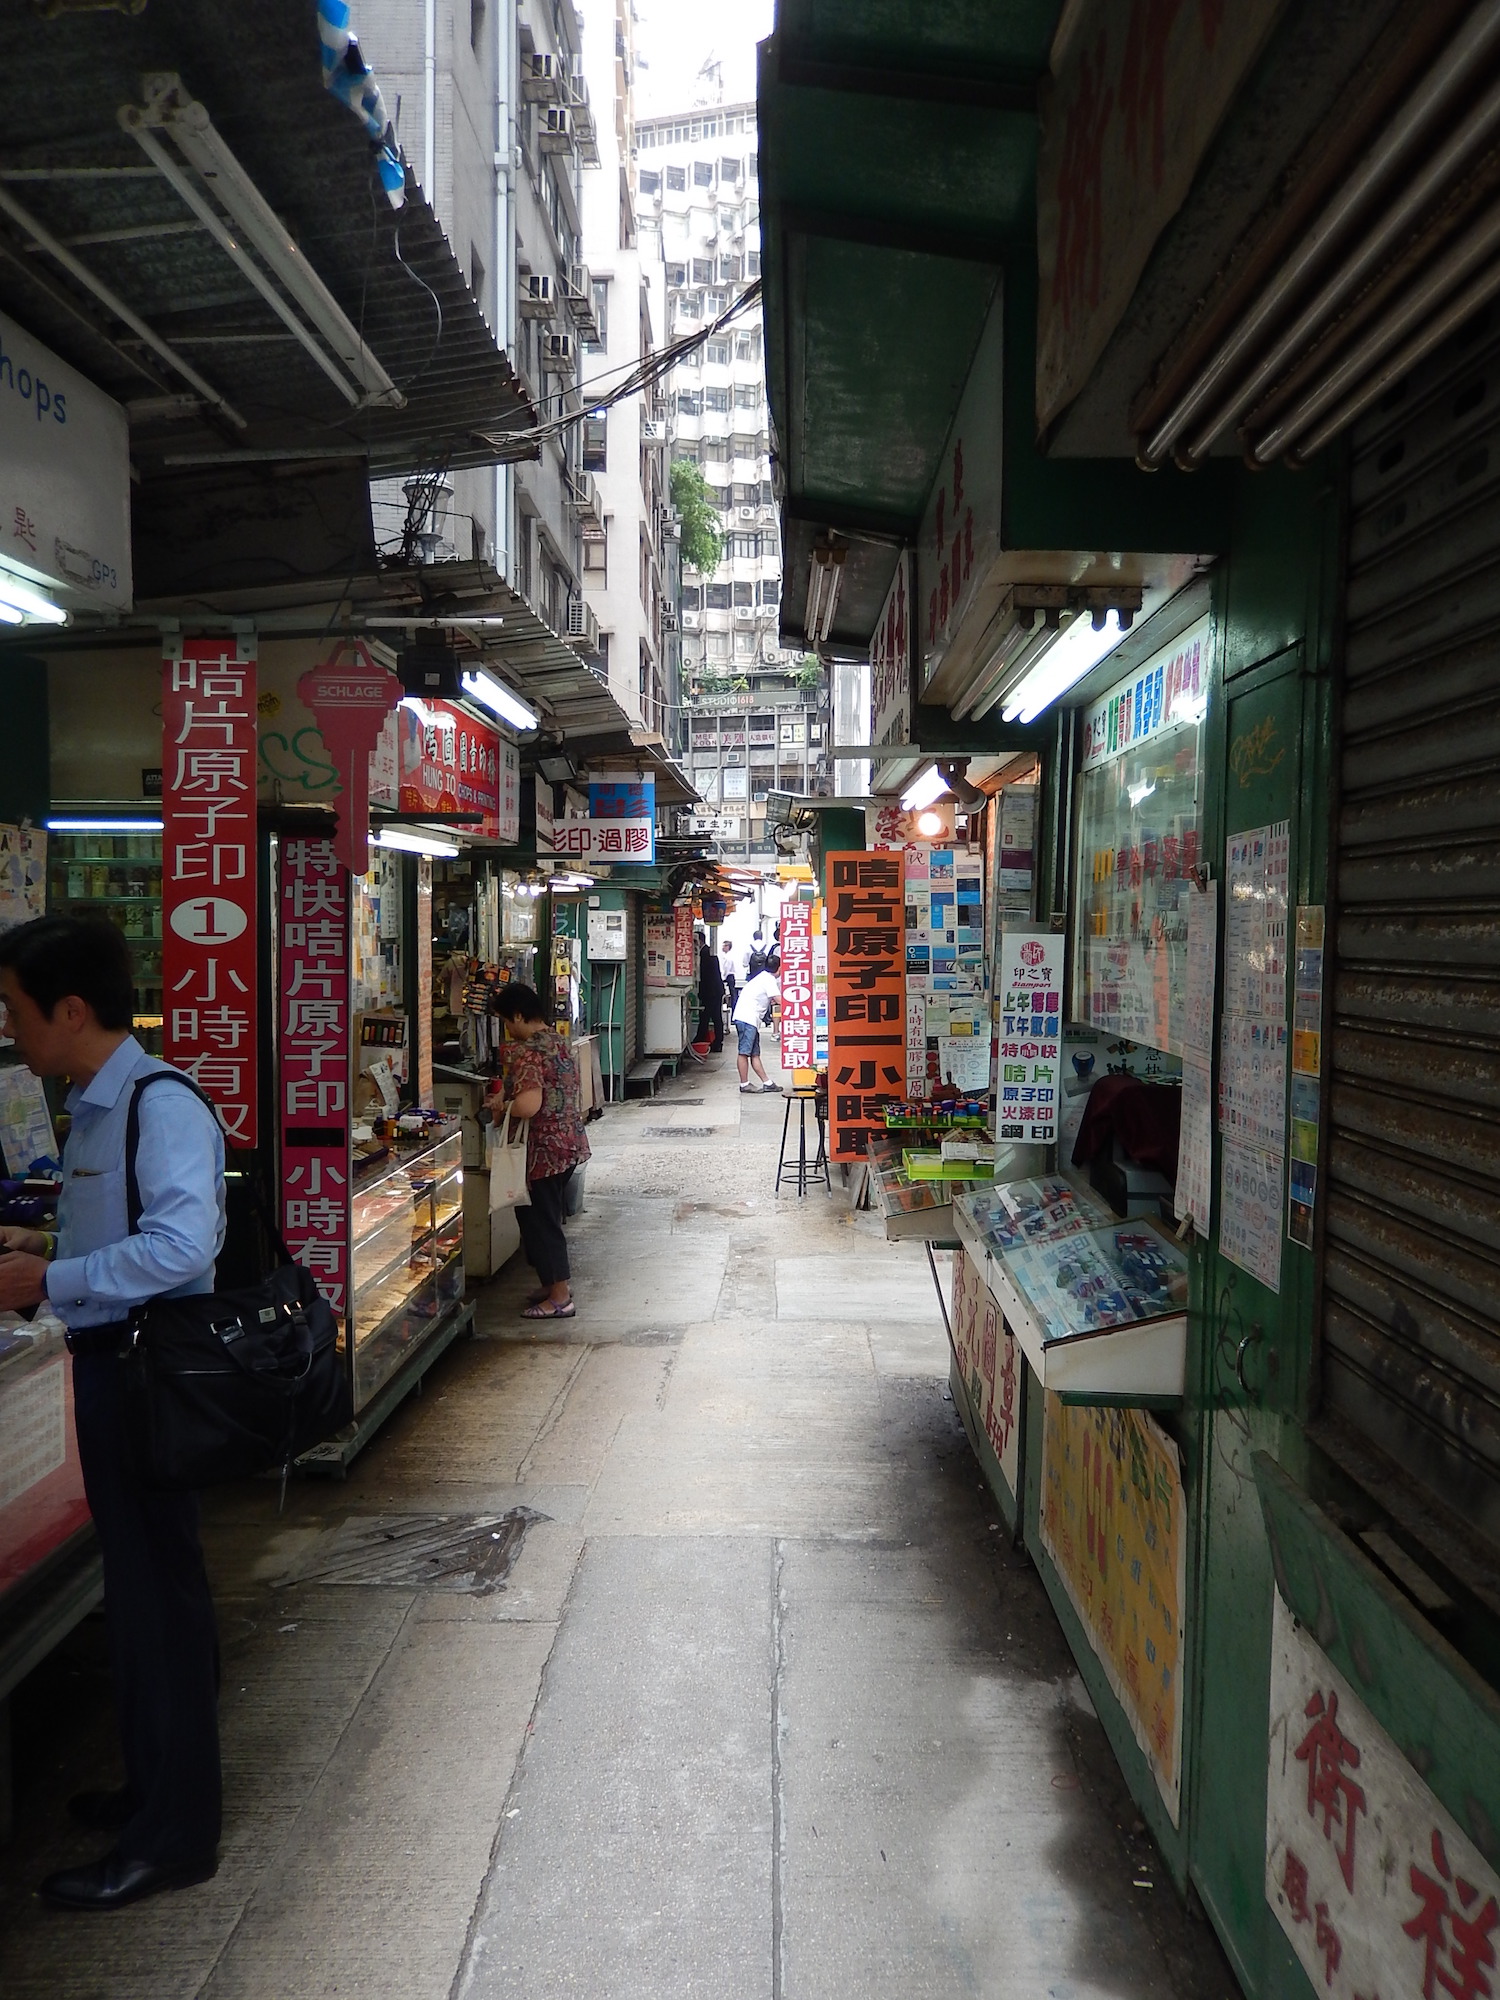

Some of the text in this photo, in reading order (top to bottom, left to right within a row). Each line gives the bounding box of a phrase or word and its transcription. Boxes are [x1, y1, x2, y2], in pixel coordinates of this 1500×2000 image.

[92, 559, 117, 589] GP3
[317, 685, 383, 698] SCHLAGE
[693, 739, 718, 747] KOON
[422, 763, 443, 792] HUNG
[445, 771, 457, 797] TO
[458, 782, 473, 803] CHOPS
[477, 790, 496, 810] PRINTING
[696, 818, 734, 829] 富生行
[1014, 967, 1054, 983] 印之寶
[1002, 991, 1060, 1014] 上午落單
[1002, 1015, 1060, 1039] 下午取貨
[908, 1050, 924, 1076] 膠印
[1003, 1063, 1054, 1083] 咭片
[908, 1080, 923, 1097] 原
[1002, 1087, 1054, 1103] 原子印
[1002, 1106, 1054, 1121] 火漆印
[1001, 1124, 1054, 1140] 鋼印
